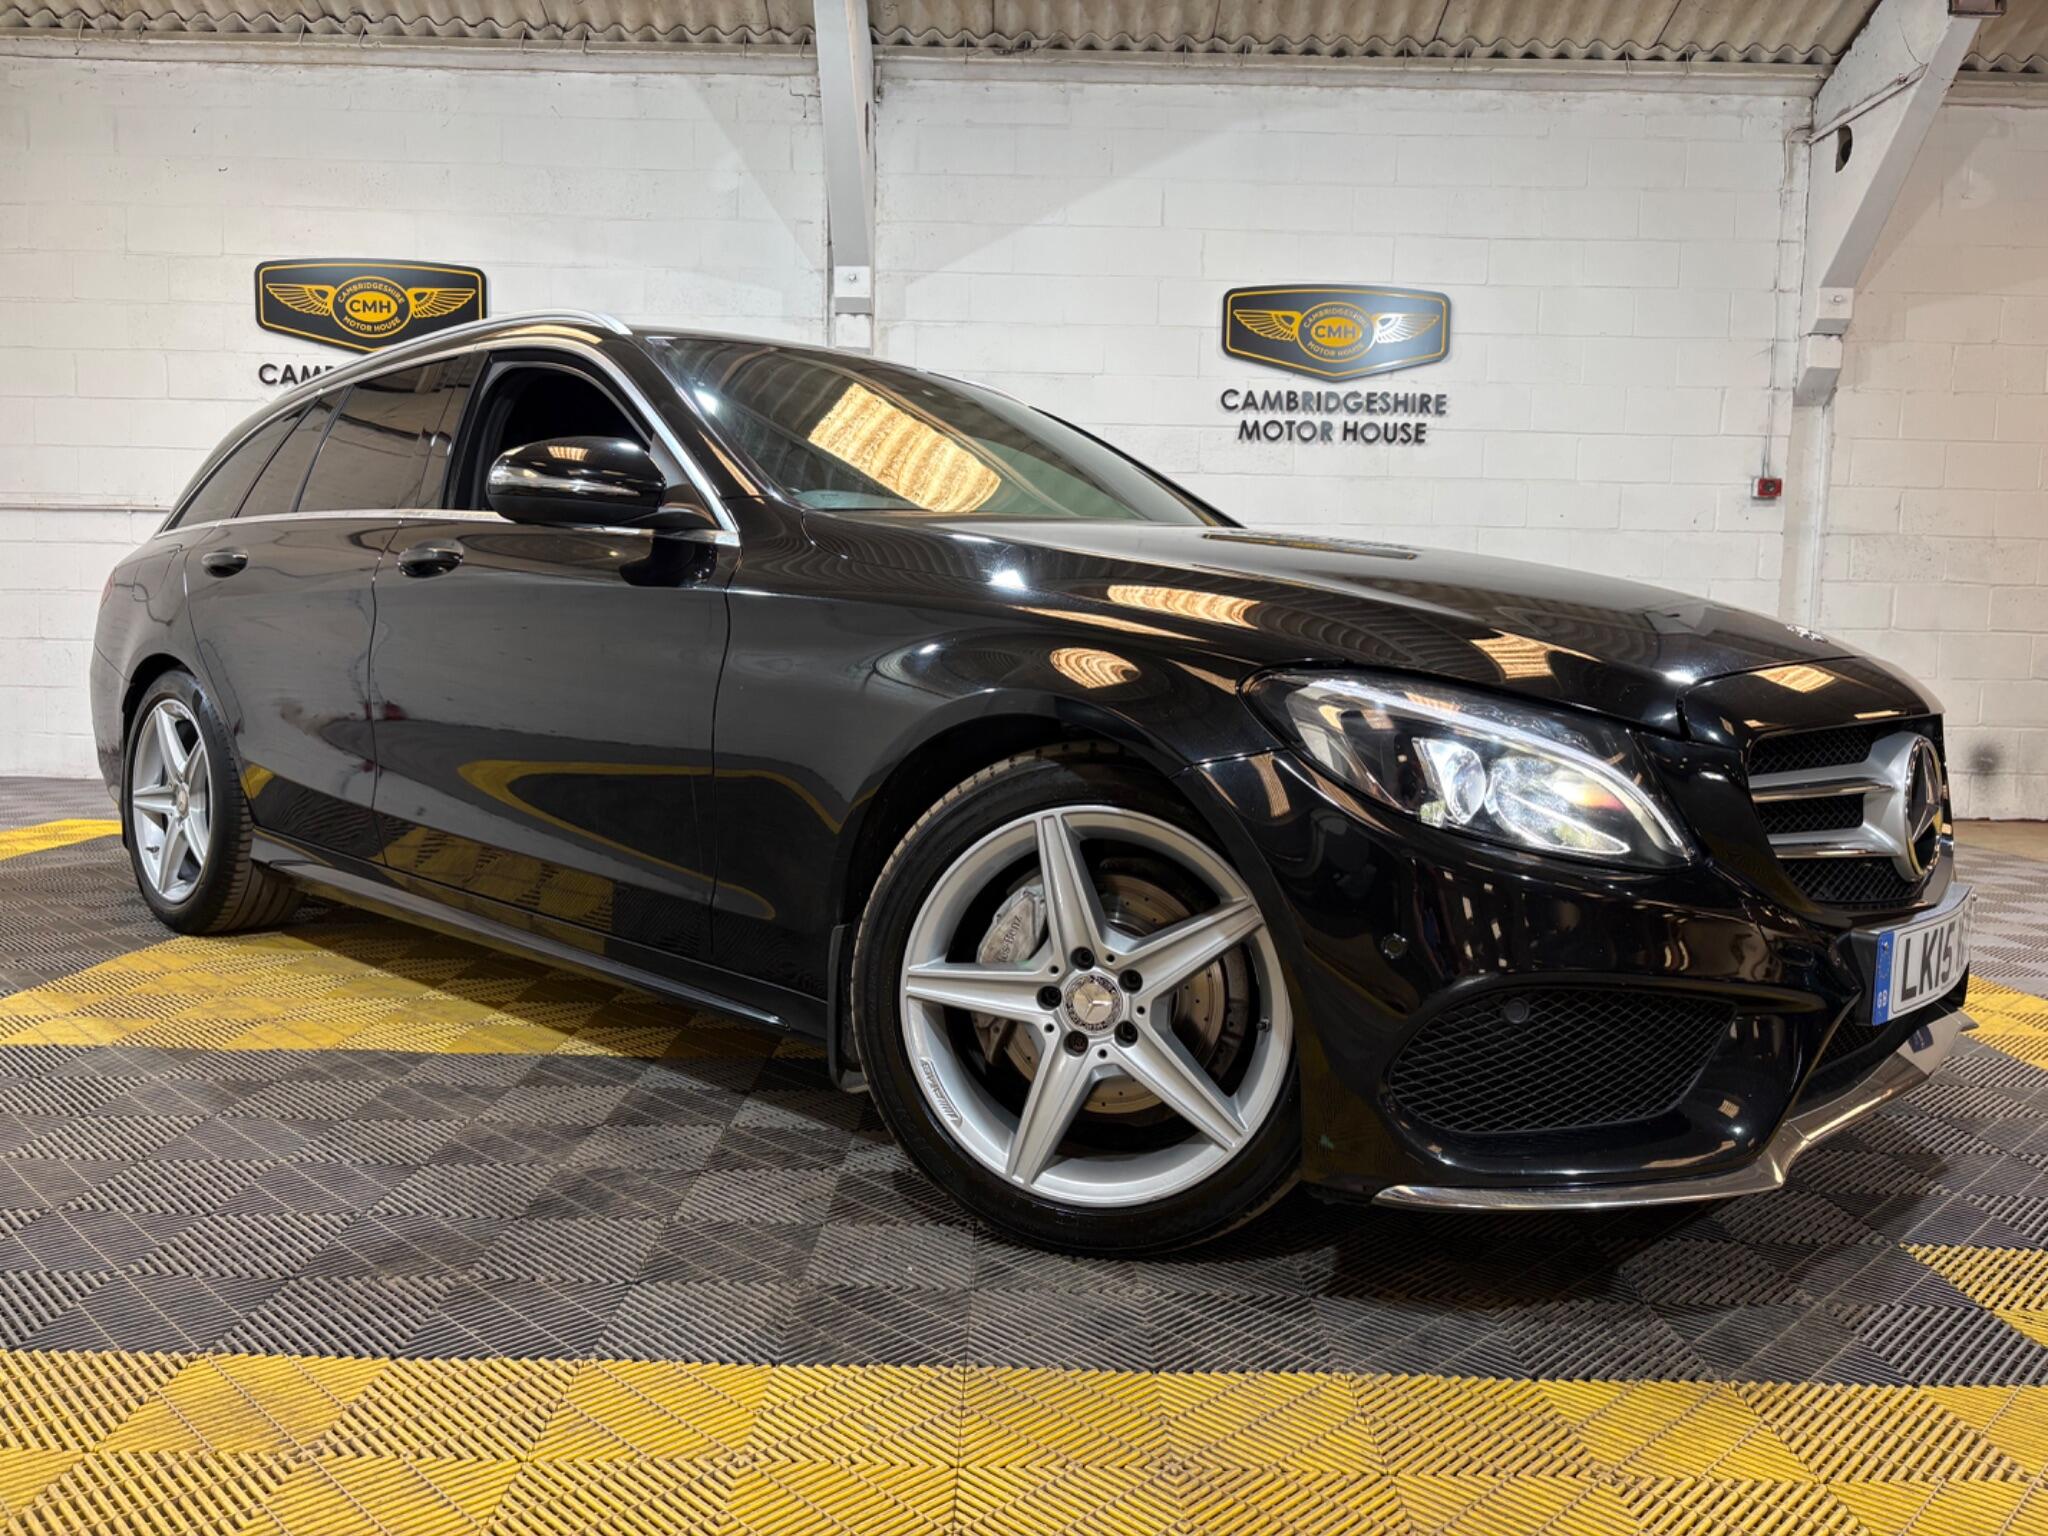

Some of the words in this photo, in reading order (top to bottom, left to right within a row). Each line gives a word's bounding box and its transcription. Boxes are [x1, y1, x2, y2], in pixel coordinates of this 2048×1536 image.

[338, 282, 405, 305] CAMBRIDGESHIRE
[349, 299, 391, 314] CMH
[343, 315, 372, 332] MOTOR
[374, 316, 401, 332] HOUSE
[1314, 325, 1356, 338] CMH
[1220, 388, 1447, 416] CAMBRIDGESHIRE
[1237, 420, 1334, 442] MOTOR
[1342, 421, 1428, 444] HOUSE
[1900, 920, 1956, 1002] LK15
